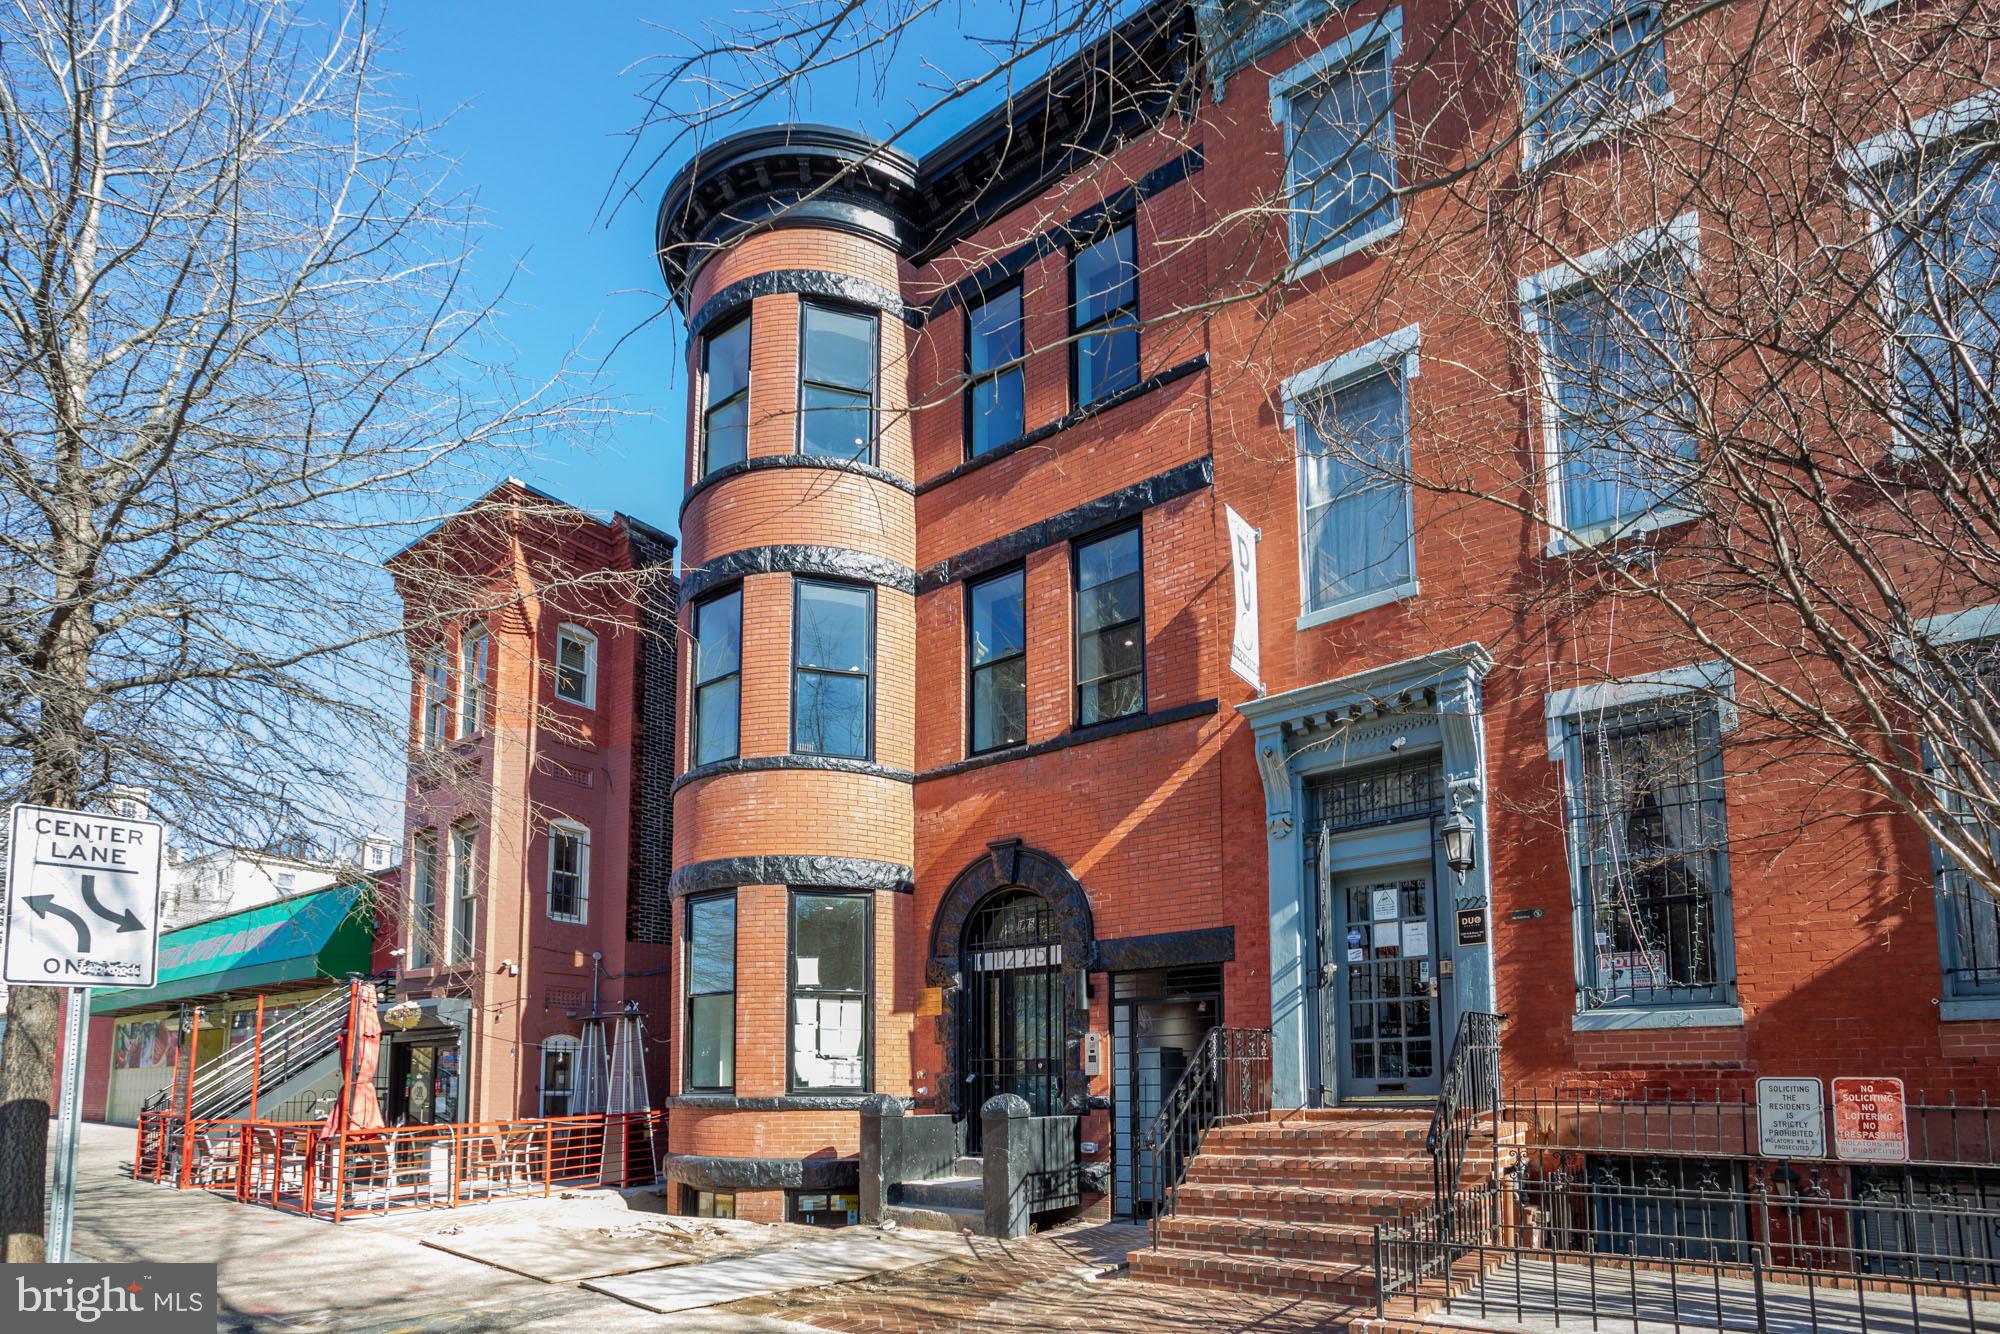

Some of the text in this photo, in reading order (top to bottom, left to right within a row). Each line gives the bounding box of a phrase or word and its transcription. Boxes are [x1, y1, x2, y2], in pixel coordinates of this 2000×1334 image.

[36, 818, 143, 845] CENTER
[52, 842, 126, 864] LANE
[1456, 895, 1488, 911] 1223
[1461, 916, 1482, 925] DUO
[995, 946, 1046, 967] 1225
[1602, 954, 1661, 968] NOTICE
[1860, 1085, 1874, 1093] NO
[1842, 1094, 1894, 1102] SOLICITING
[1861, 1103, 1875, 1111] NO
[1845, 1112, 1893, 1120] LOITERING
[1862, 1122, 1876, 1130] NO
[1768, 1129, 1814, 1138] PROHIBITED
[1840, 1130, 1903, 1139] TRESPASSING
